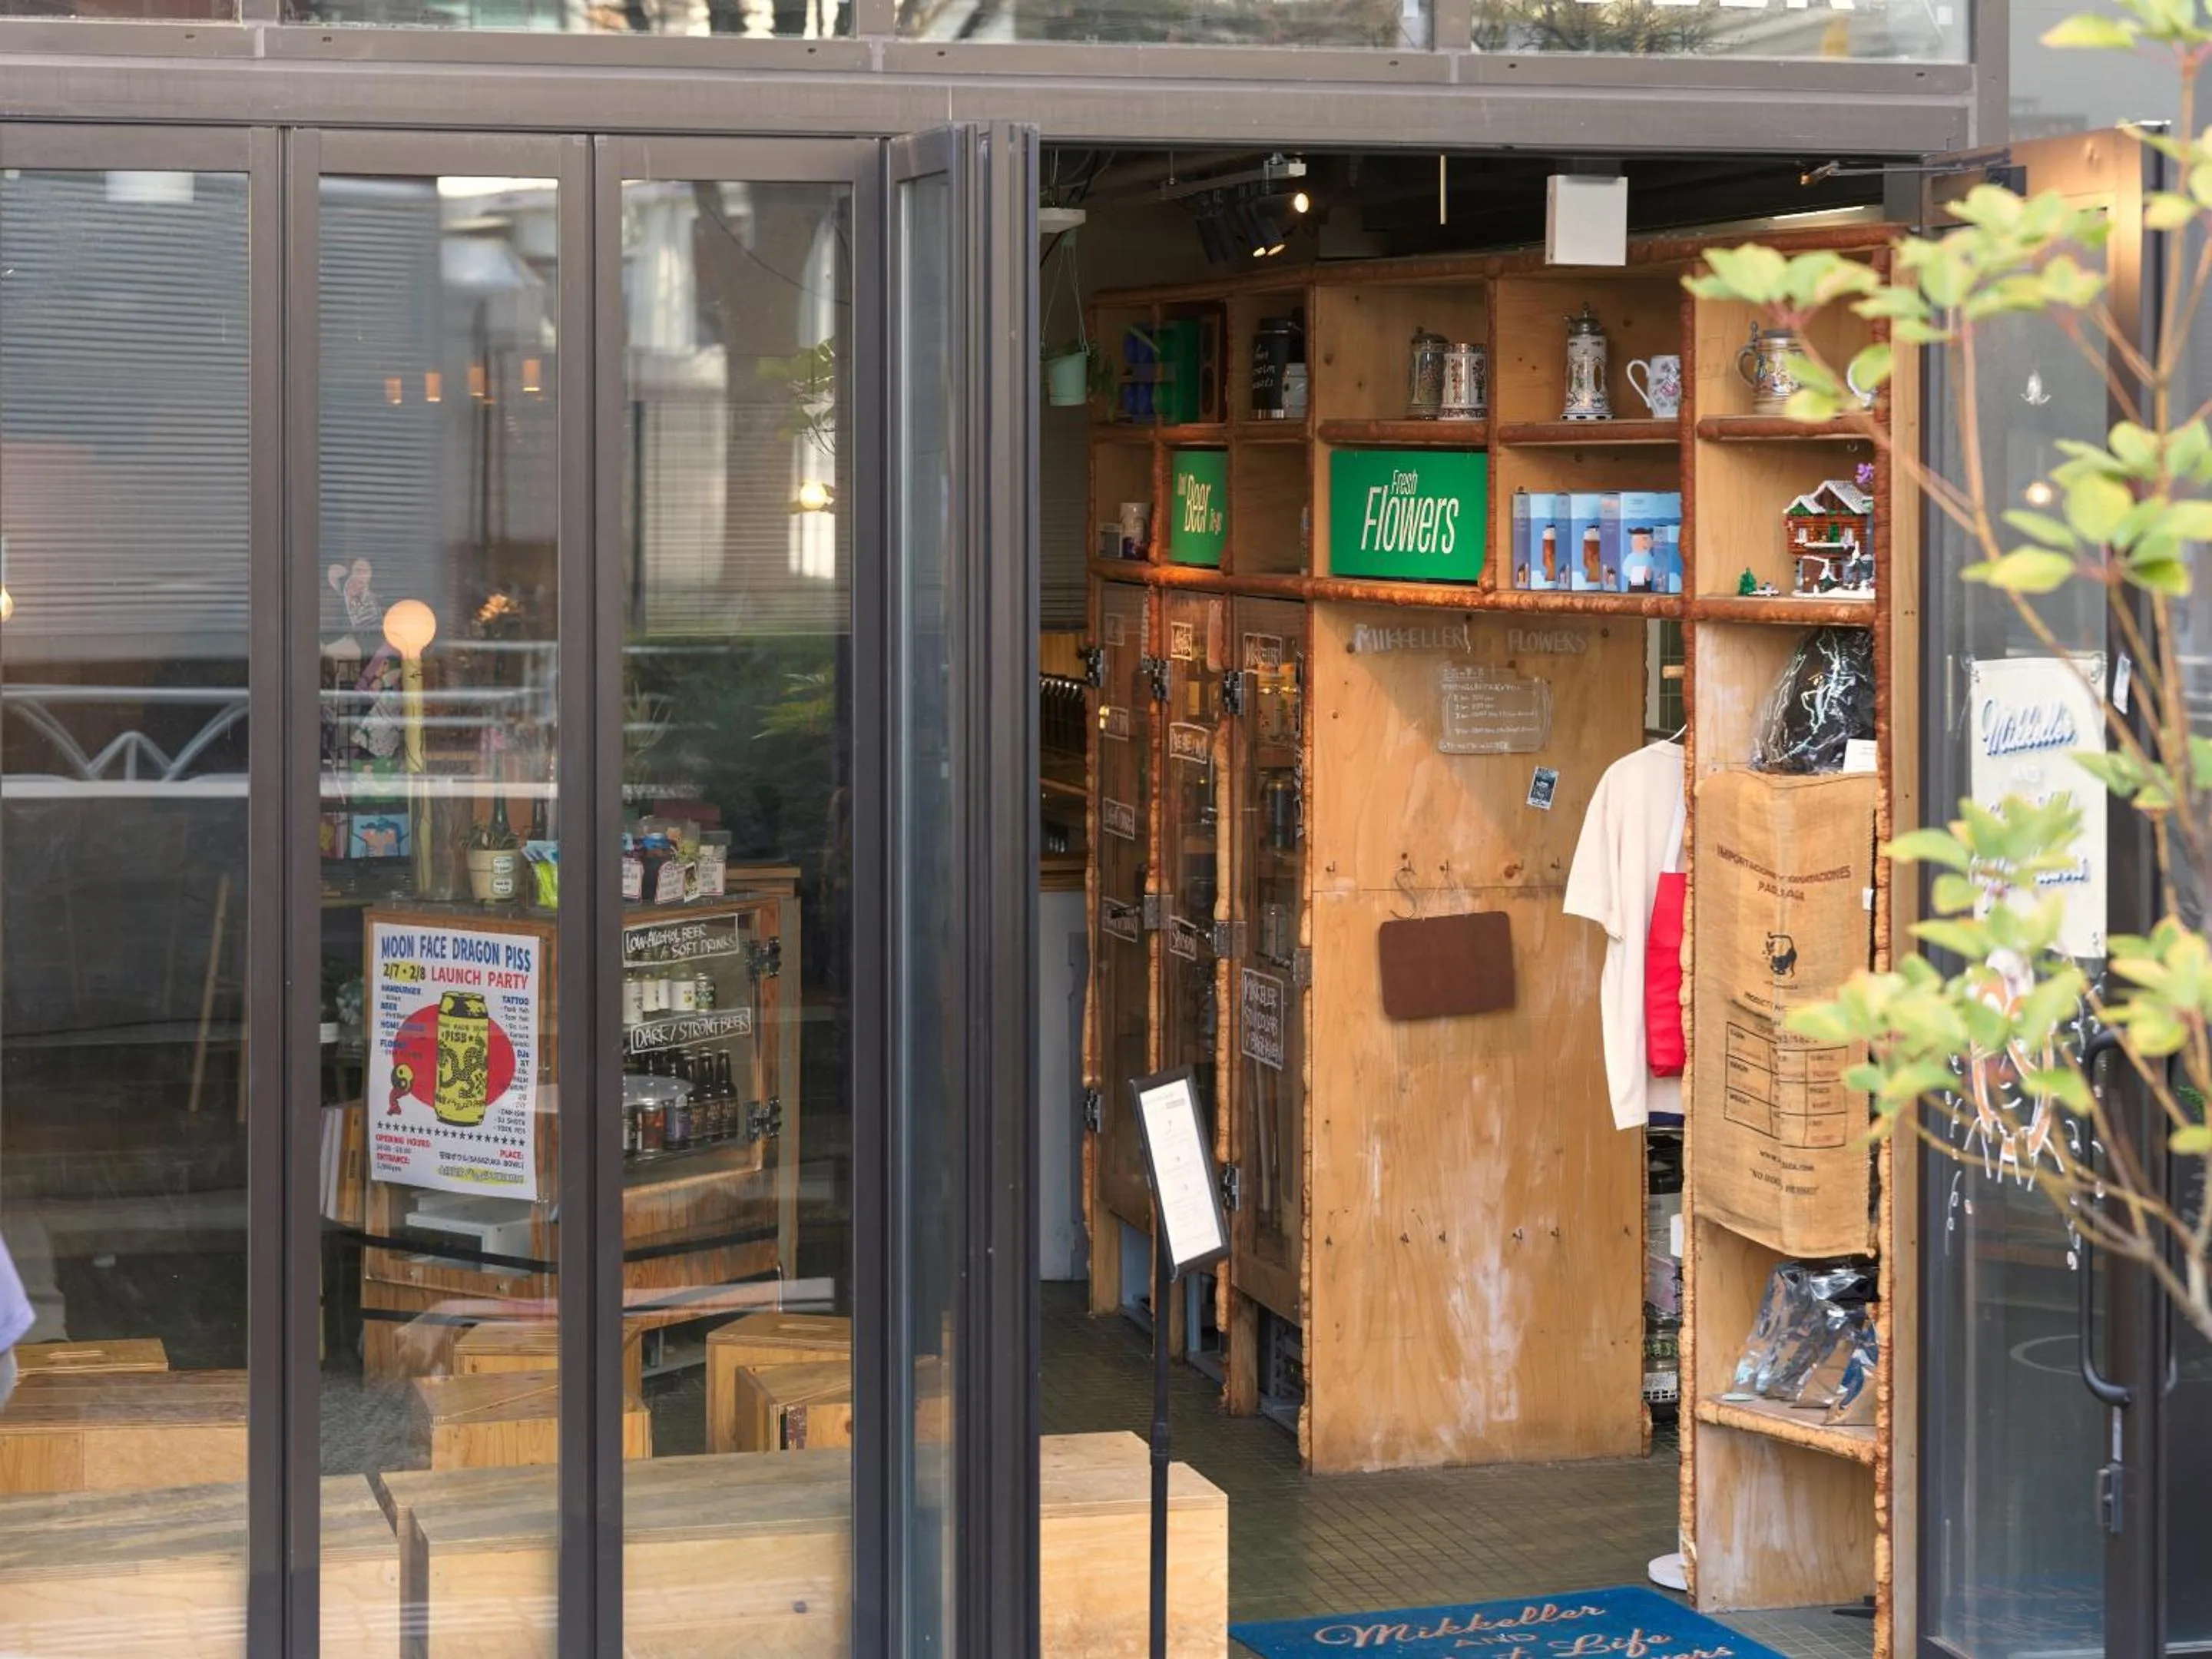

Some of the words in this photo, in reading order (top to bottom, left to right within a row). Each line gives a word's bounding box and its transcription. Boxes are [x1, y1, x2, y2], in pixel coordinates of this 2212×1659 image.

[1390, 469, 1418, 495] Fresh
[1184, 474, 1211, 533] Beer
[1360, 485, 1459, 554] Flowers
[1507, 628, 1588, 653] FLOWERS
[381, 935, 414, 959] MOON
[419, 935, 446, 959] FACE
[452, 936, 499, 966] DRAGON
[505, 944, 531, 972] PISS
[382, 962, 399, 980] 2/7
[409, 963, 426, 982] 2/8
[431, 965, 482, 985] LAUNCH
[488, 971, 528, 990] PARTY
[502, 995, 530, 1006] TATTOO
[376, 1152, 412, 1165] ENTRANCE:
[499, 1149, 525, 1160] PLACE:
[1313, 1604, 1606, 1647] Mikkeller
[1546, 1628, 1674, 1658] Life
